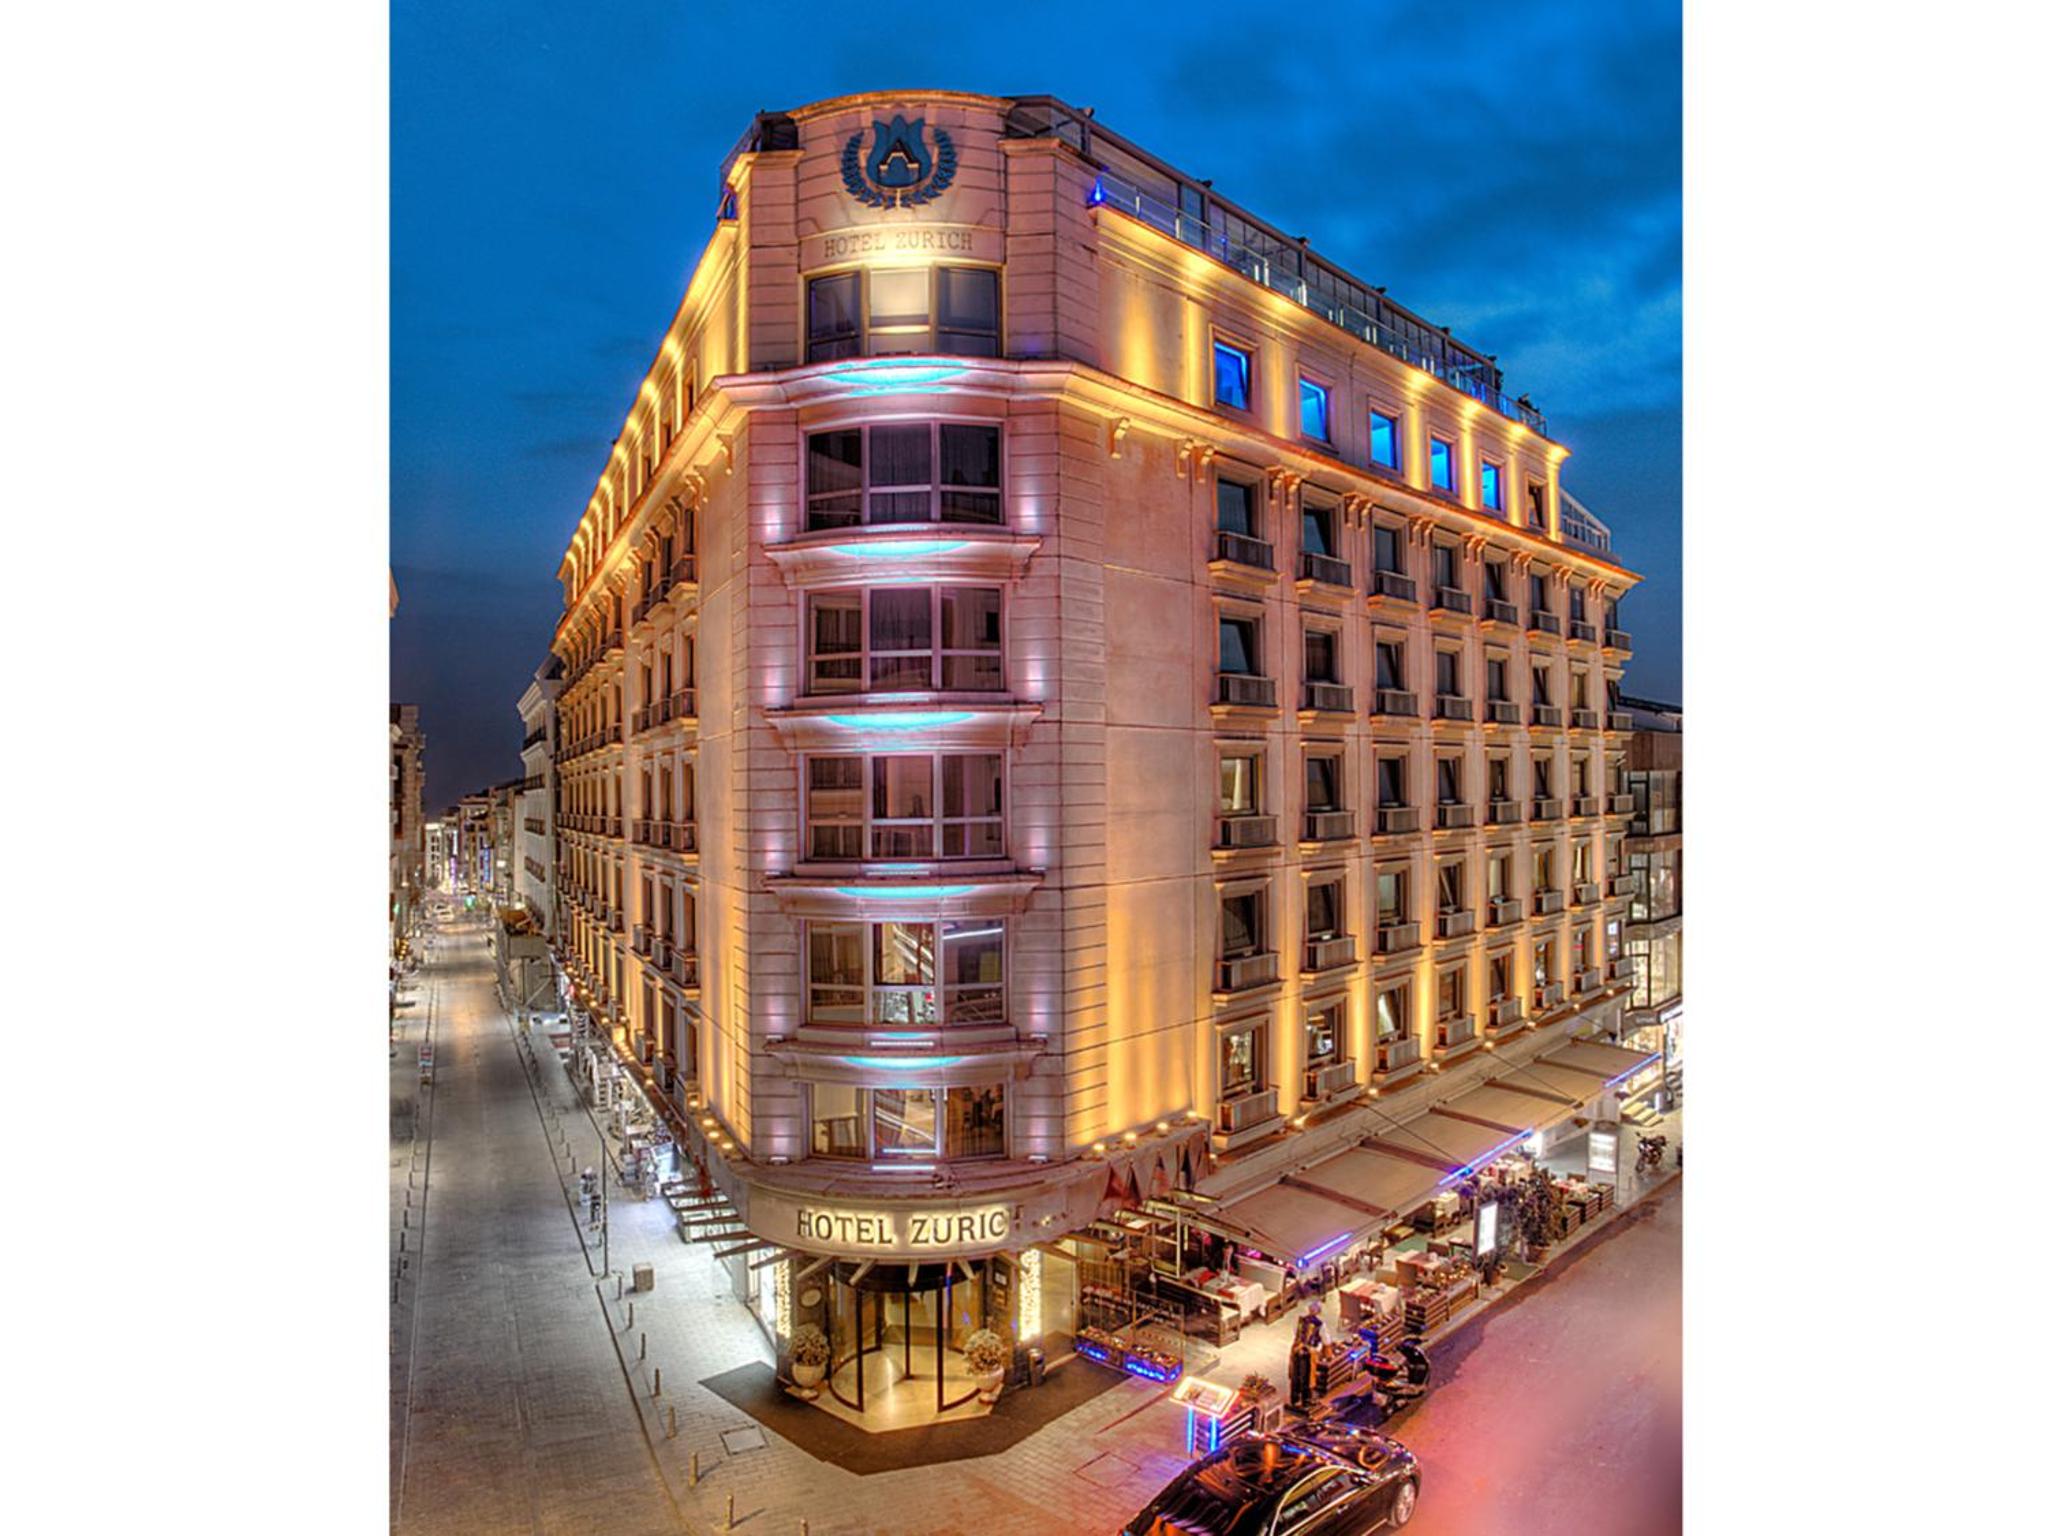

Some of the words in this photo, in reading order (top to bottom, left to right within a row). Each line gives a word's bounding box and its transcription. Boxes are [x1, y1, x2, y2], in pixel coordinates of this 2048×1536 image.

[823, 232, 886, 259] HOTEL
[895, 231, 974, 251] ZURICH
[797, 1209, 893, 1244] HOTEL
